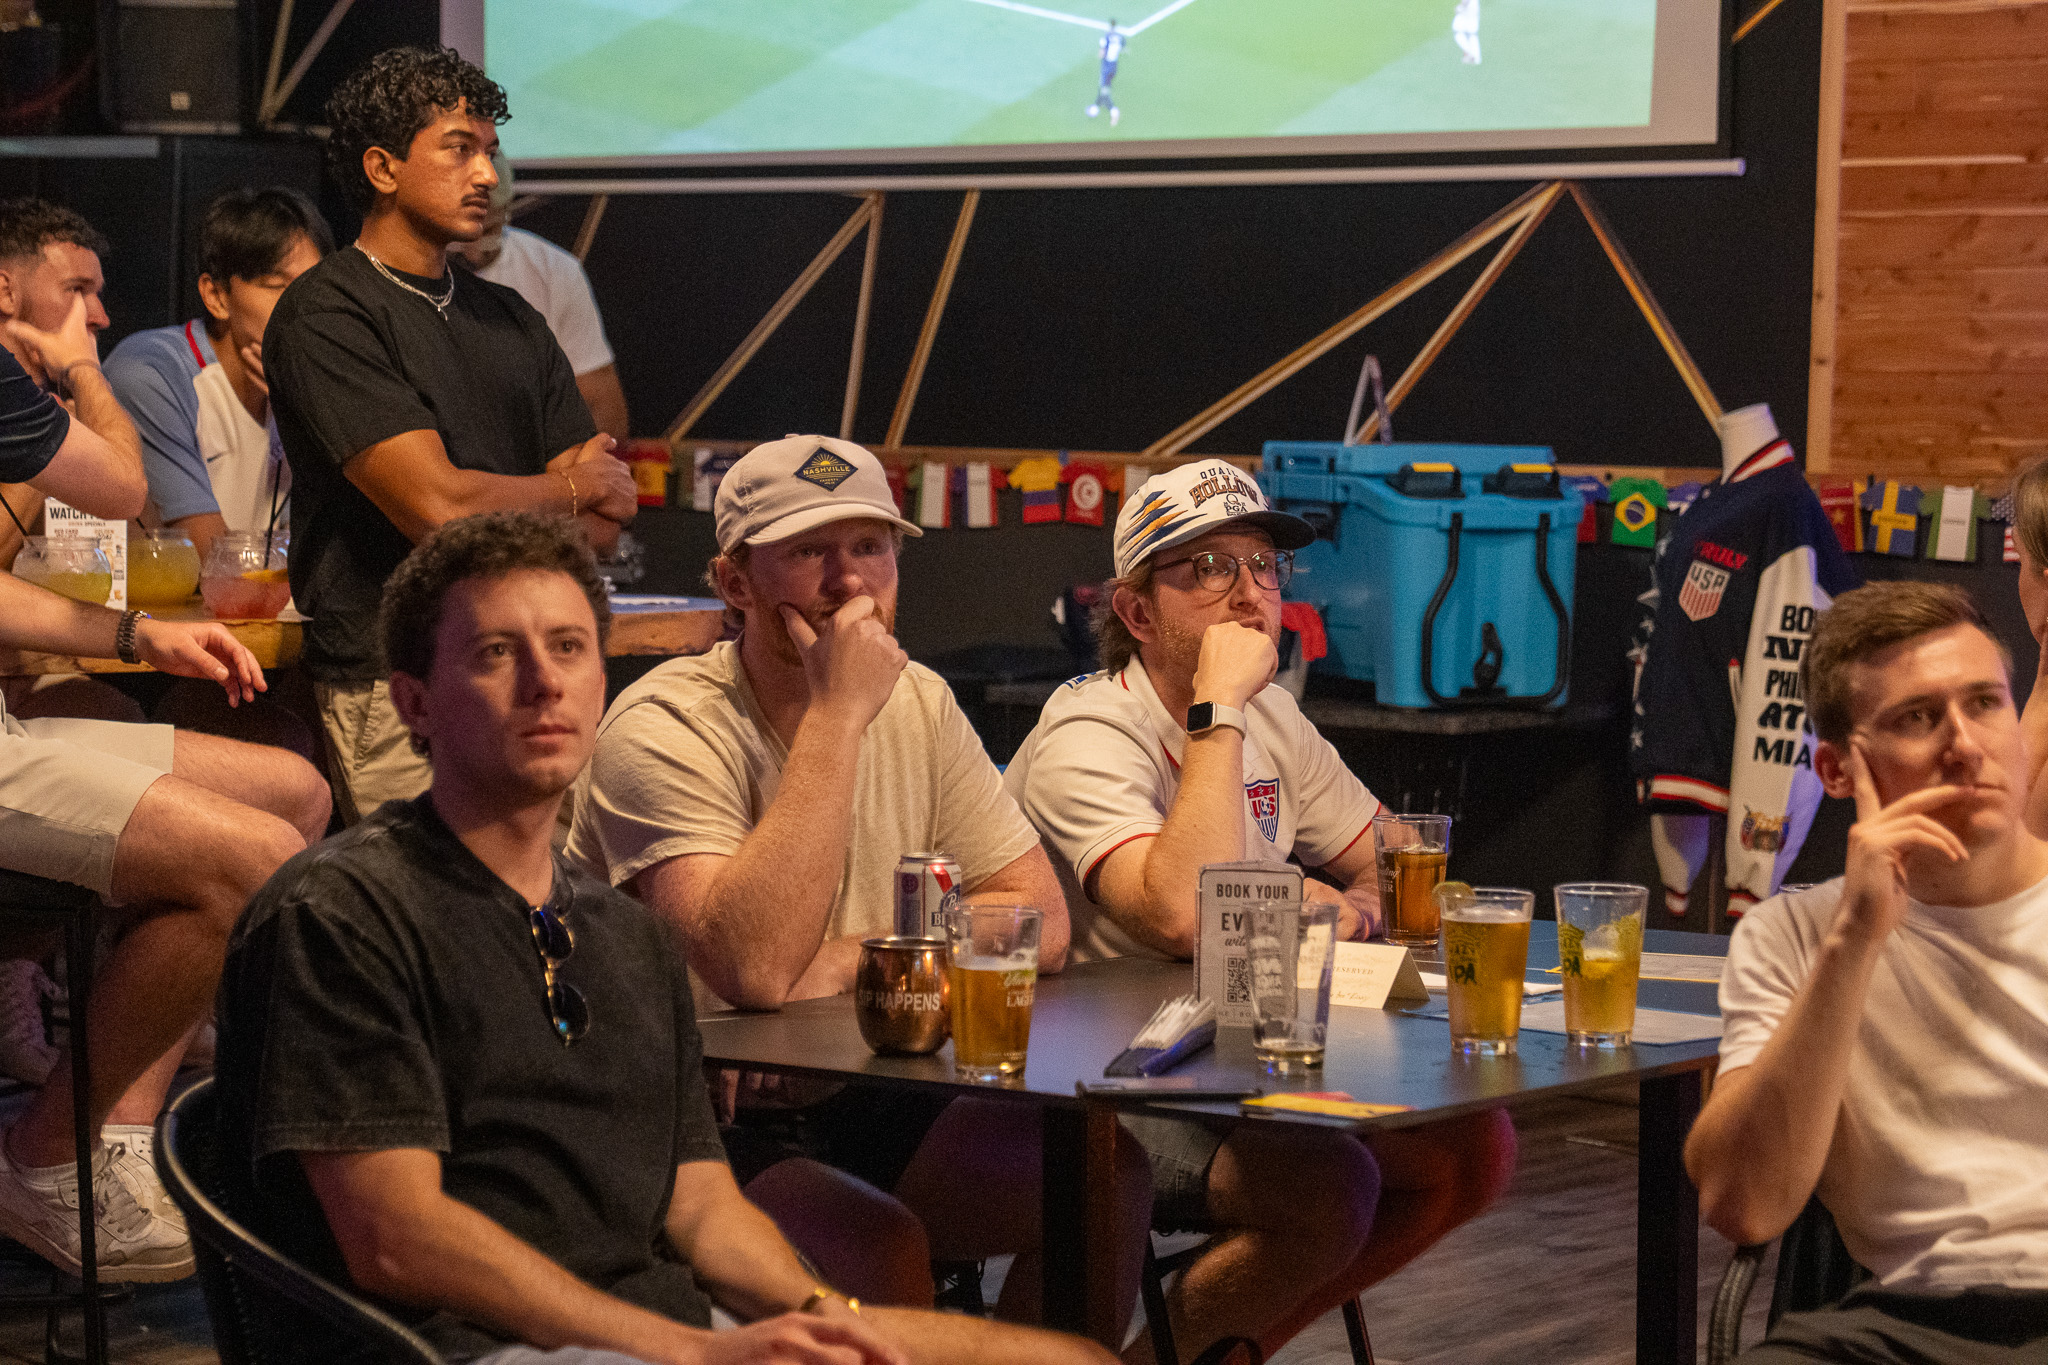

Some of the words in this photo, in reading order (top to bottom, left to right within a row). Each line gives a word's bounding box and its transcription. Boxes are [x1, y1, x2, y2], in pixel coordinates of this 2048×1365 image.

[803, 466, 850, 475] NASHVILLE
[1200, 467, 1238, 479] QUAIL
[1189, 475, 1259, 509] HOLLOW
[1226, 505, 1248, 513] PGA
[1695, 541, 1748, 569] TRULY
[1691, 565, 1726, 590] USA
[1781, 605, 1814, 633] BO
[1216, 884, 1251, 898] BOOK
[1255, 885, 1290, 900] YOUR
[876, 992, 940, 1011] HAPPENS
